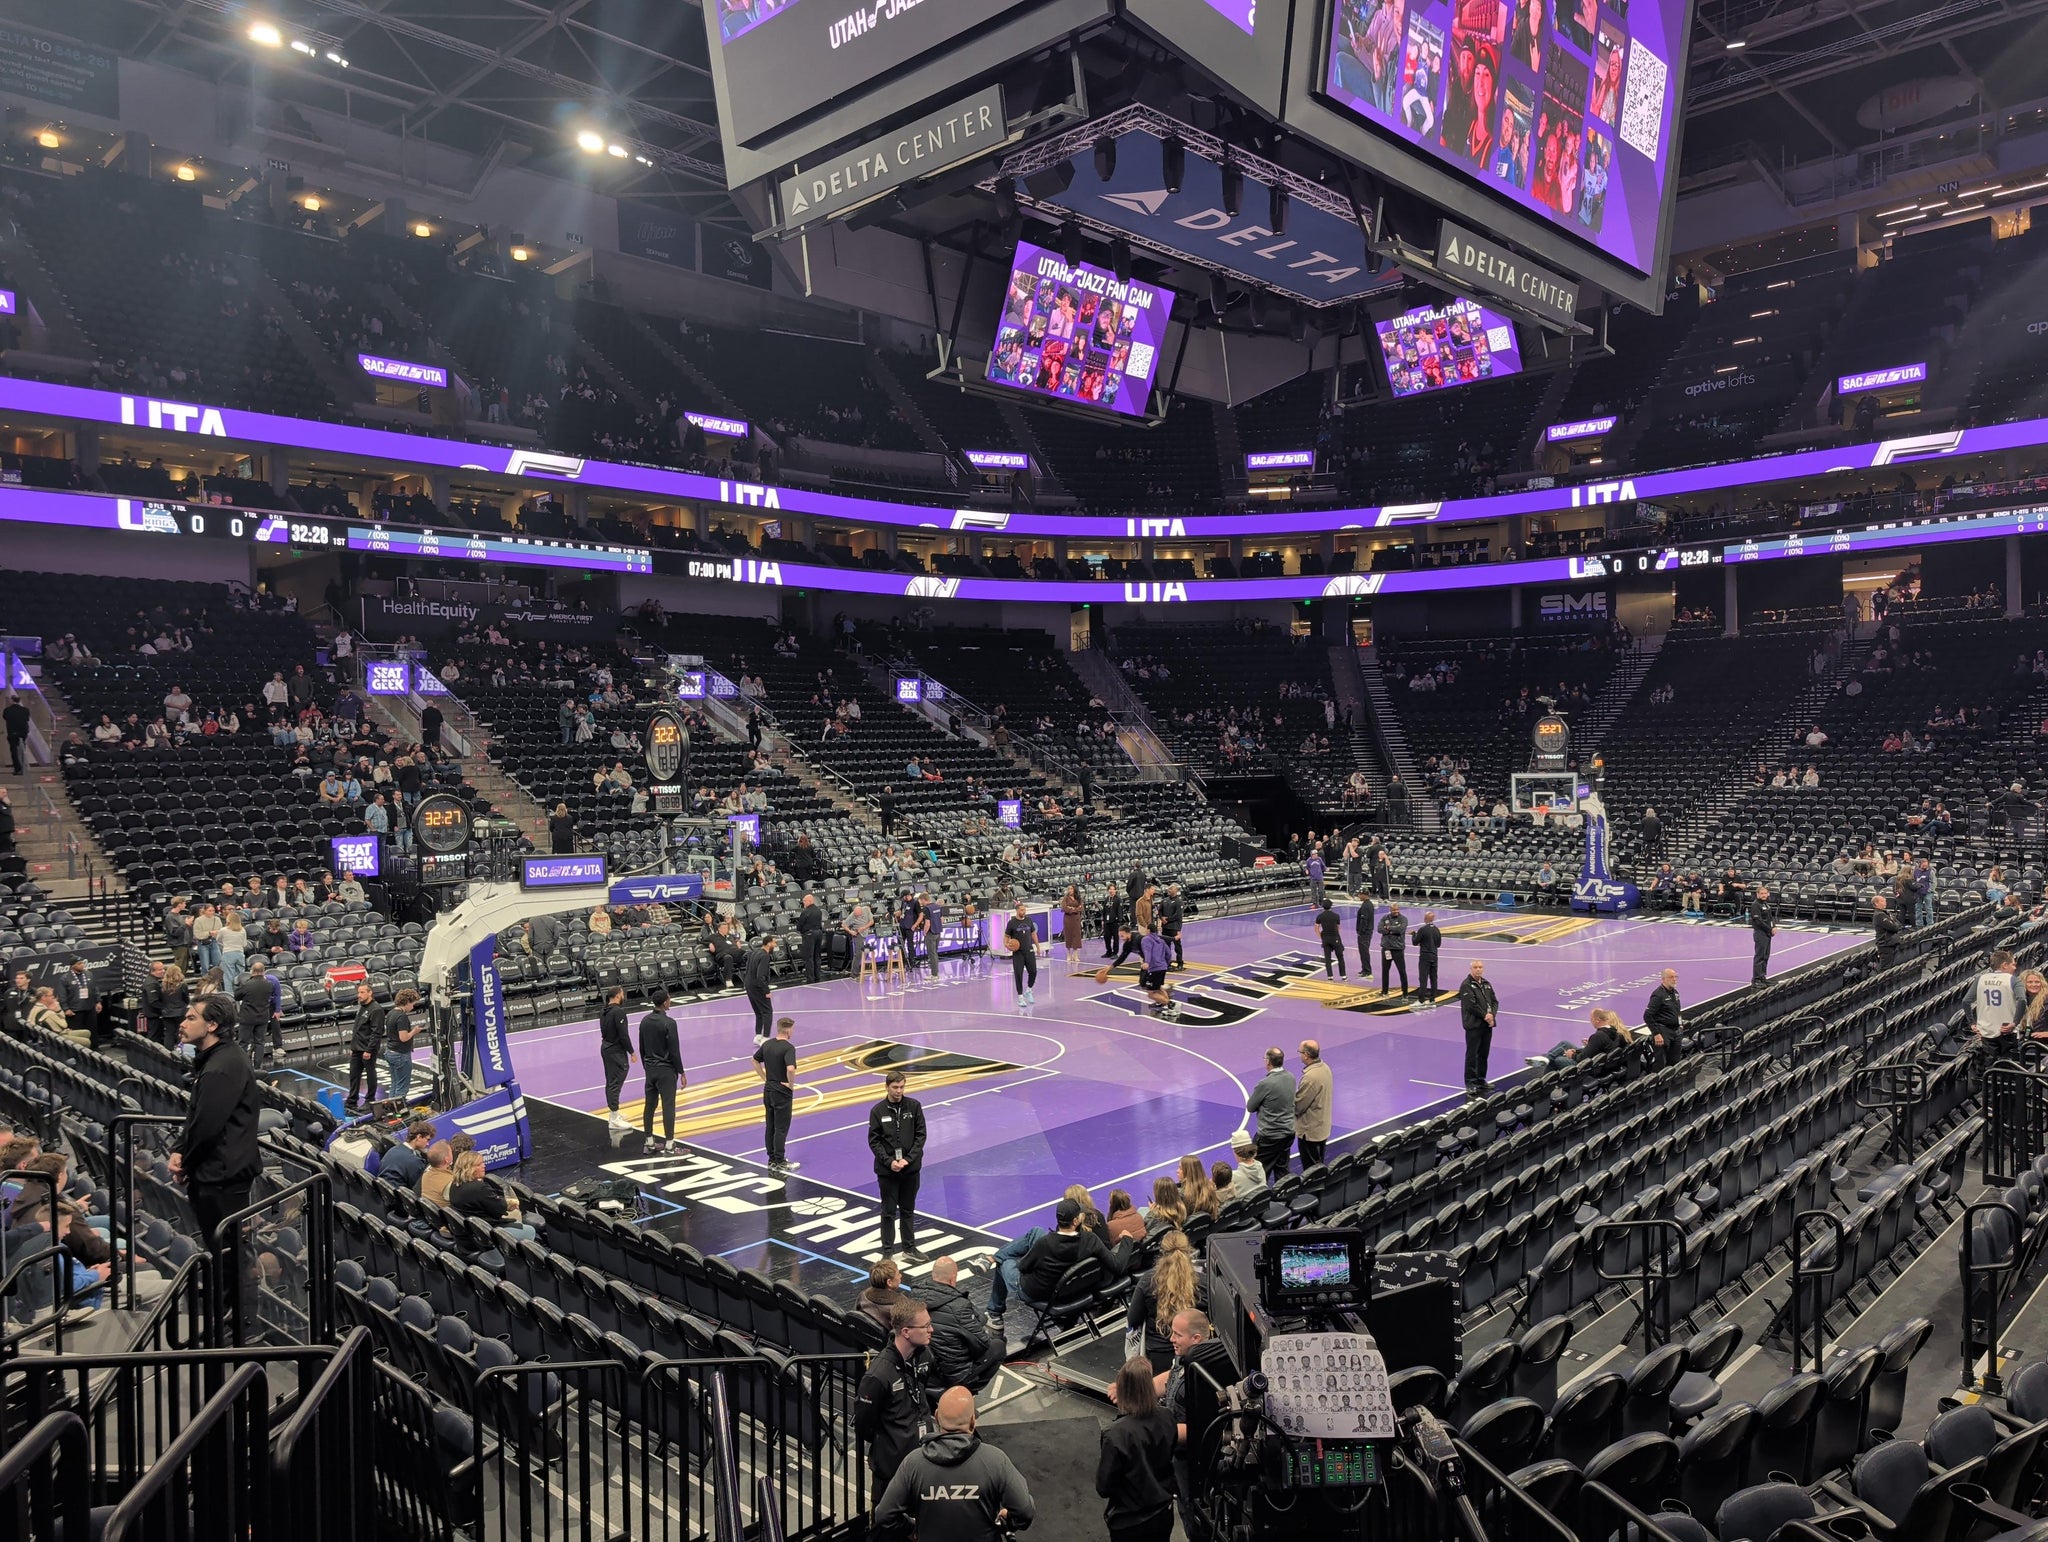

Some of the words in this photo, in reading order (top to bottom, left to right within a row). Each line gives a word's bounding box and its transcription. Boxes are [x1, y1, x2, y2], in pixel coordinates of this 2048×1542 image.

[829, 8, 867, 49] UTAH
[885, 0, 924, 19] JA
[813, 153, 888, 203] DELTA
[897, 105, 993, 164] CENTER
[1173, 208, 1360, 283] DELTA
[1038, 257, 1068, 282] UTAH
[1077, 271, 1106, 294] JAZZ
[1106, 280, 1128, 301] FAN
[1128, 287, 1152, 309] CAM
[1464, 245, 1515, 288] DELTA
[1521, 272, 1573, 313] CENTER
[1392, 315, 1415, 329] UTAH
[1446, 302, 1465, 316] FAN
[363, 358, 385, 373] SAC
[423, 369, 442, 383] UTA
[1843, 377, 1862, 390] SAC
[1901, 367, 1921, 379] UTA
[1684, 378, 1726, 397] aptive
[1728, 372, 1755, 388] lofts
[1551, 427, 1567, 437] SAC
[1597, 420, 1613, 430] UTA
[969, 454, 984, 463] SAC
[1010, 456, 1024, 466] UTA
[1251, 456, 1266, 465] SAC
[1294, 454, 1308, 463] UTA
[191, 515, 204, 533] 0
[231, 518, 243, 537] 0
[291, 524, 329, 544] 32:28
[333, 537, 346, 546] 1ST
[1614, 559, 1622, 572] 0
[1639, 556, 1647, 570] 0
[1680, 550, 1709, 567] 32:28
[1712, 555, 1722, 563] 1ST
[689, 561, 714, 578] 07:00
[716, 563, 731, 579] PM
[383, 600, 477, 621] HealthEquity
[1540, 591, 1606, 614] SME
[373, 667, 403, 679] SEAT
[372, 679, 405, 691] GEEK
[900, 681, 918, 690] SEAT
[899, 690, 918, 699] GEEK
[1539, 724, 1561, 734] 32:27
[659, 785, 681, 794] TISSOT
[425, 810, 461, 826] 32:27
[338, 843, 372, 858] SEAT
[435, 853, 467, 862] TISSOT
[529, 866, 548, 878] SAC
[584, 864, 601, 875] UTA
[481, 965, 495, 1006] FIRST
[1984, 989, 2002, 1007] 19
[484, 1007, 504, 1072] AMERICA
[499, 1147, 517, 1158] FIRST
[920, 1485, 980, 1500] JAZZ
